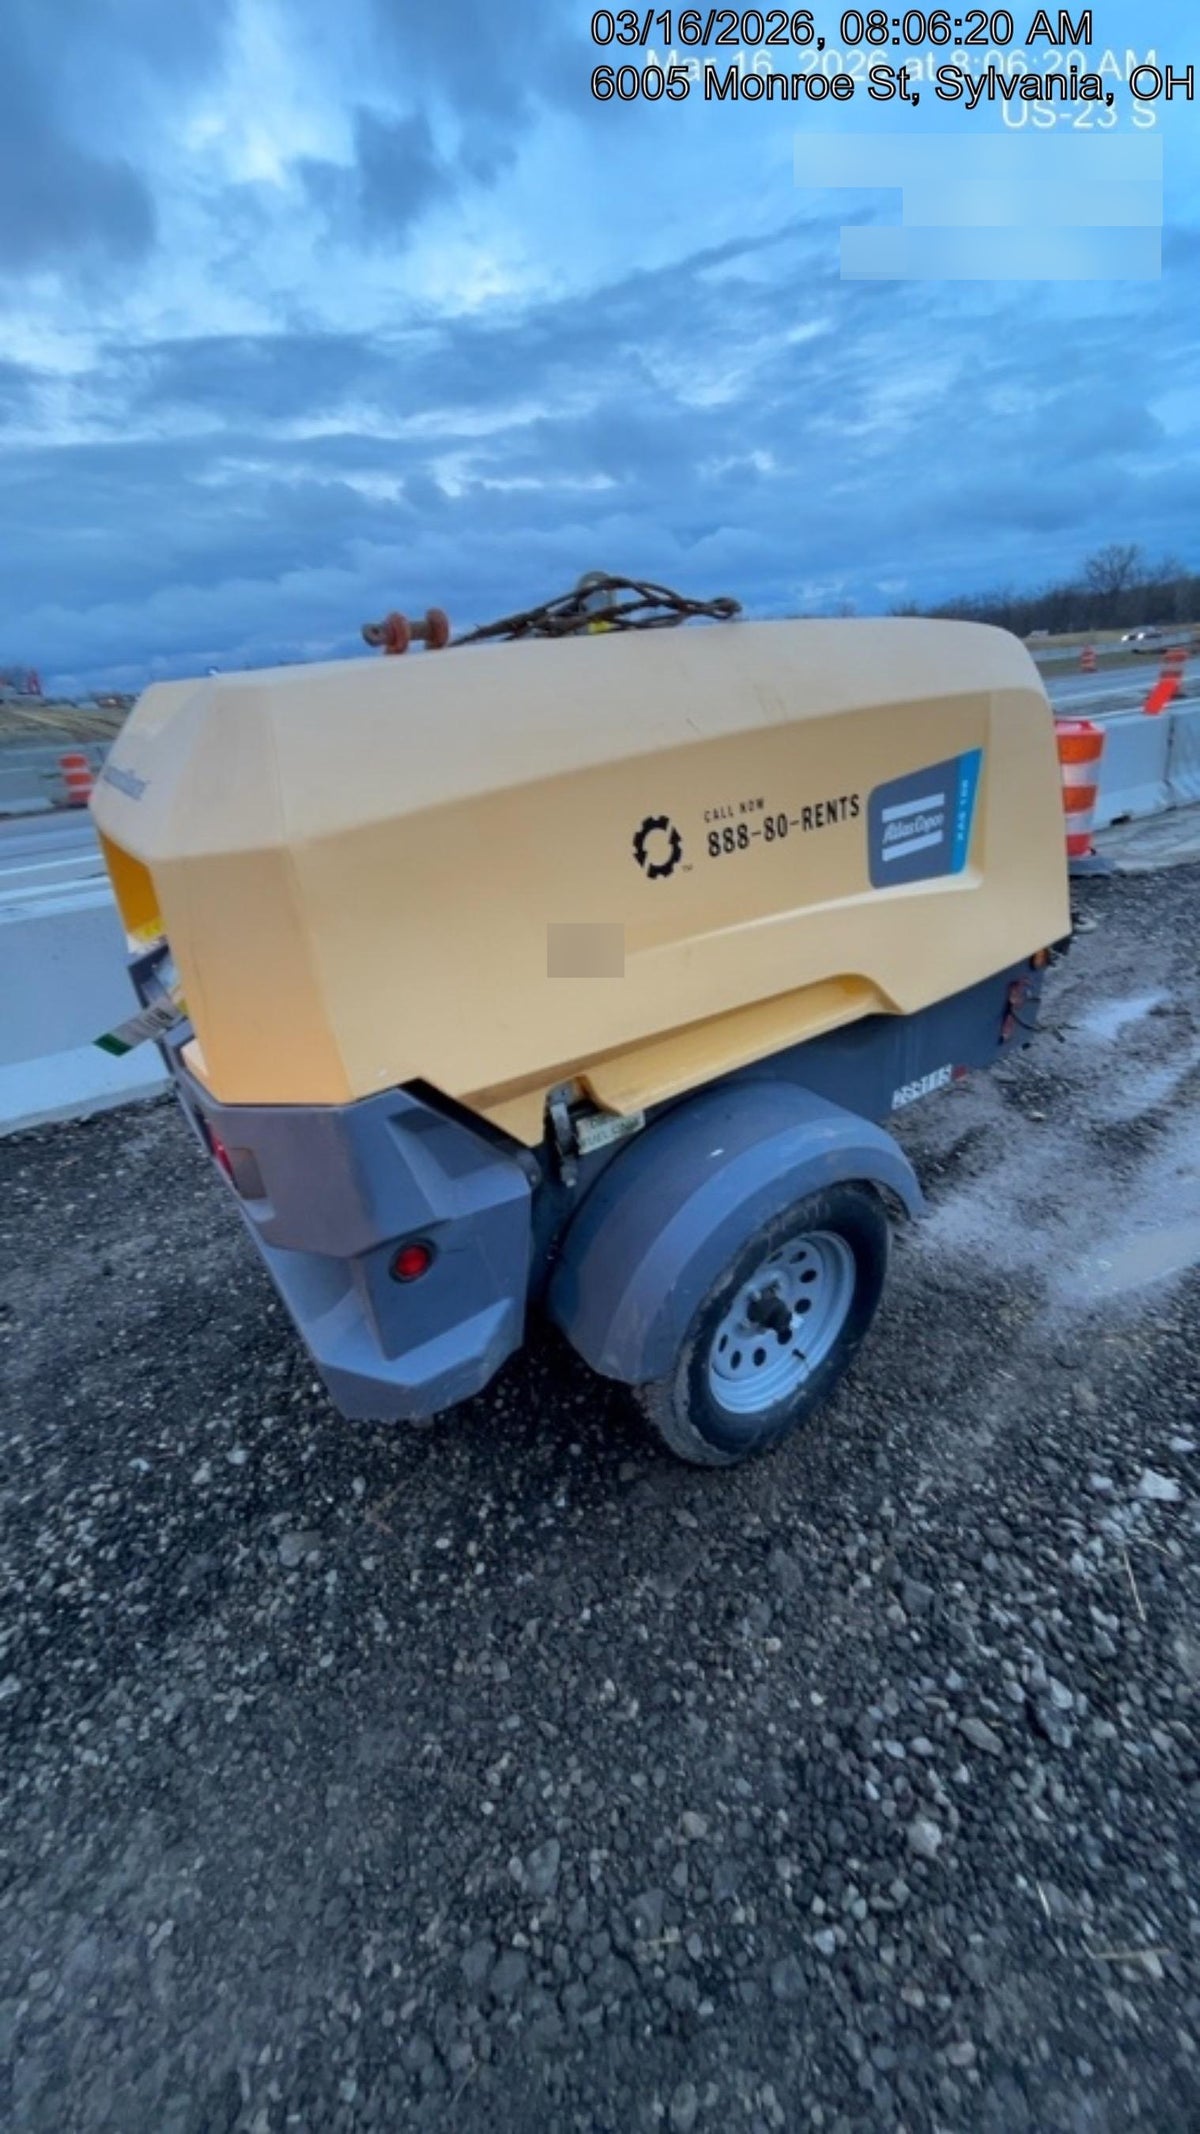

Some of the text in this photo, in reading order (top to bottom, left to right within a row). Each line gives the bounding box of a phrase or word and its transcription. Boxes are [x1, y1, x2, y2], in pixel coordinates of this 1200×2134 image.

[704, 797, 765, 824] CALL NOW
[708, 794, 860, 857] 888-80-RENTS
